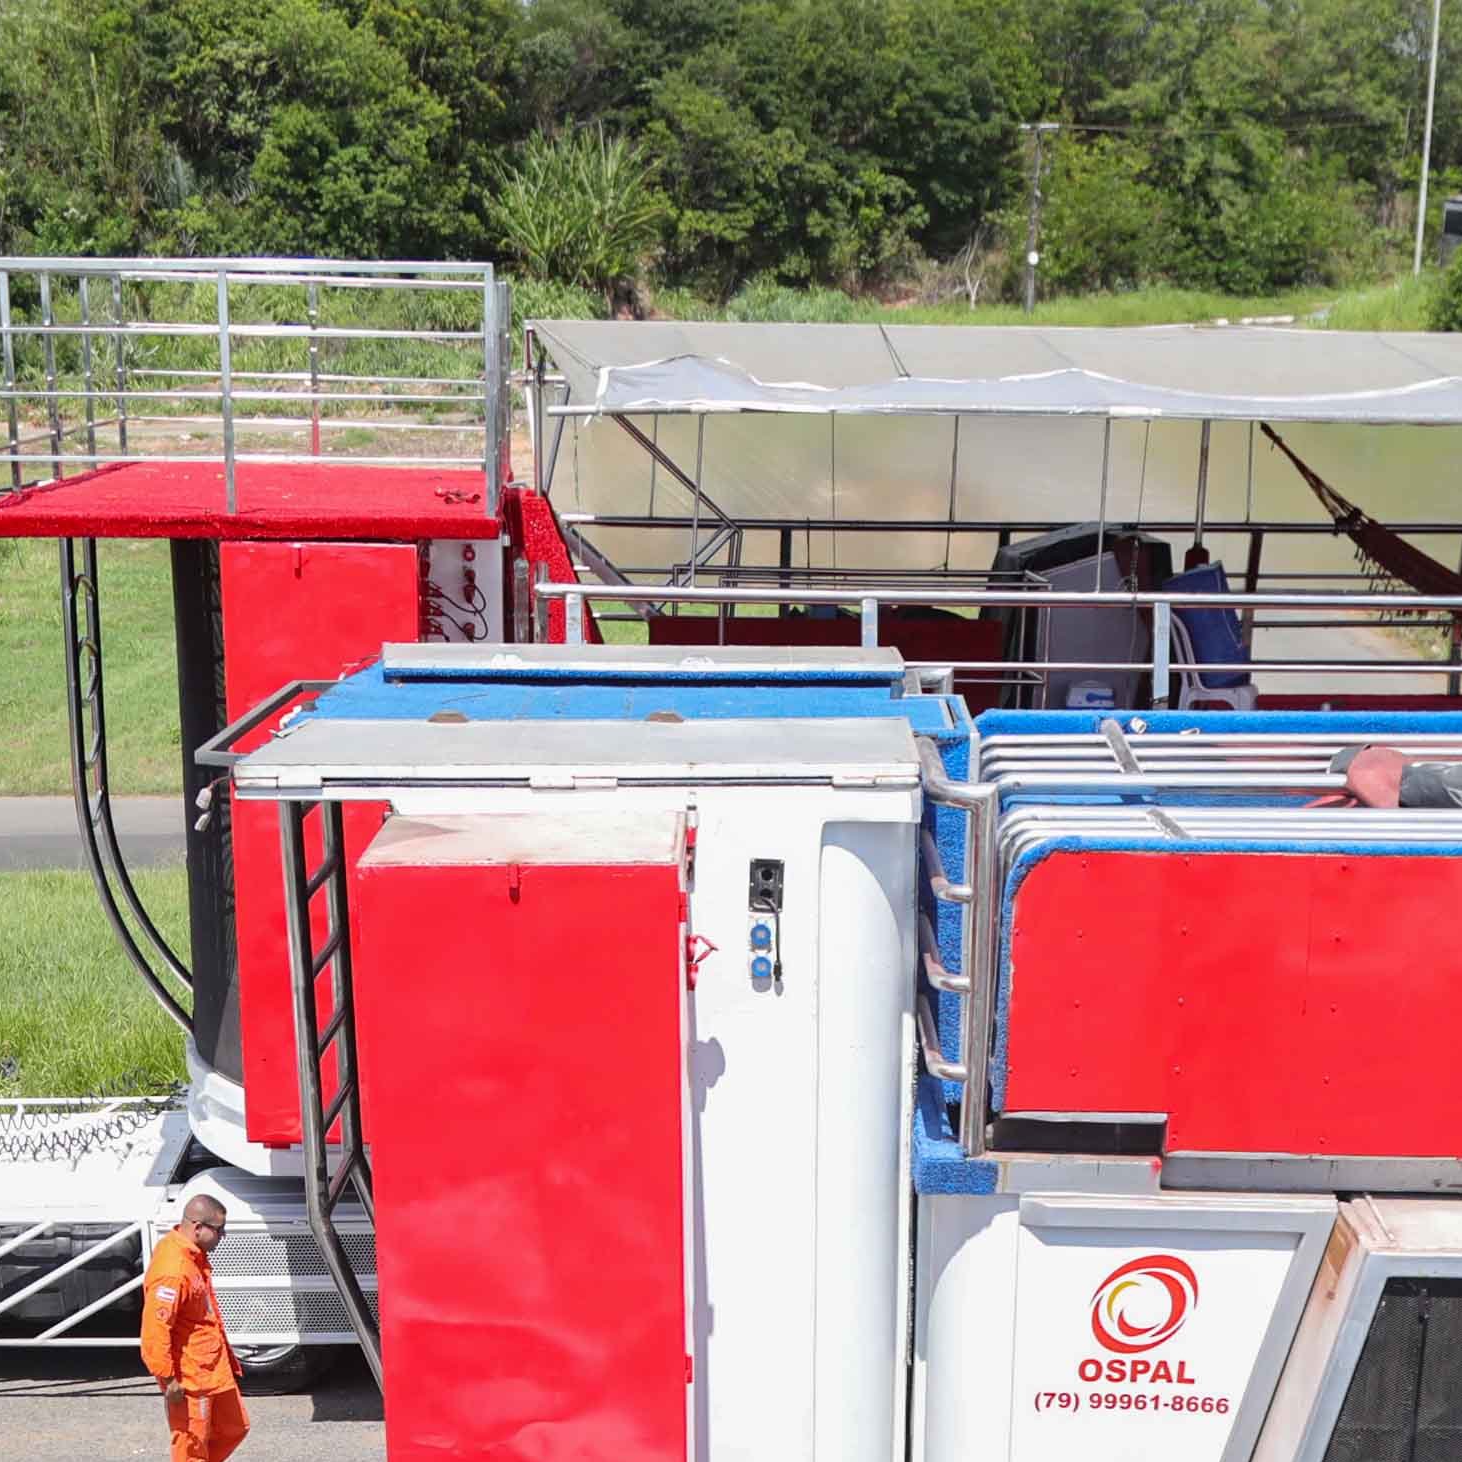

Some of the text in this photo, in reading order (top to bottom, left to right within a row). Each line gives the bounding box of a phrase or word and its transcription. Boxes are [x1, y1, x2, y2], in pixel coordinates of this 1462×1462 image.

[1078, 1359, 1195, 1384] OSPAL
[1034, 1392, 1230, 1414] (79) 99961-8666
